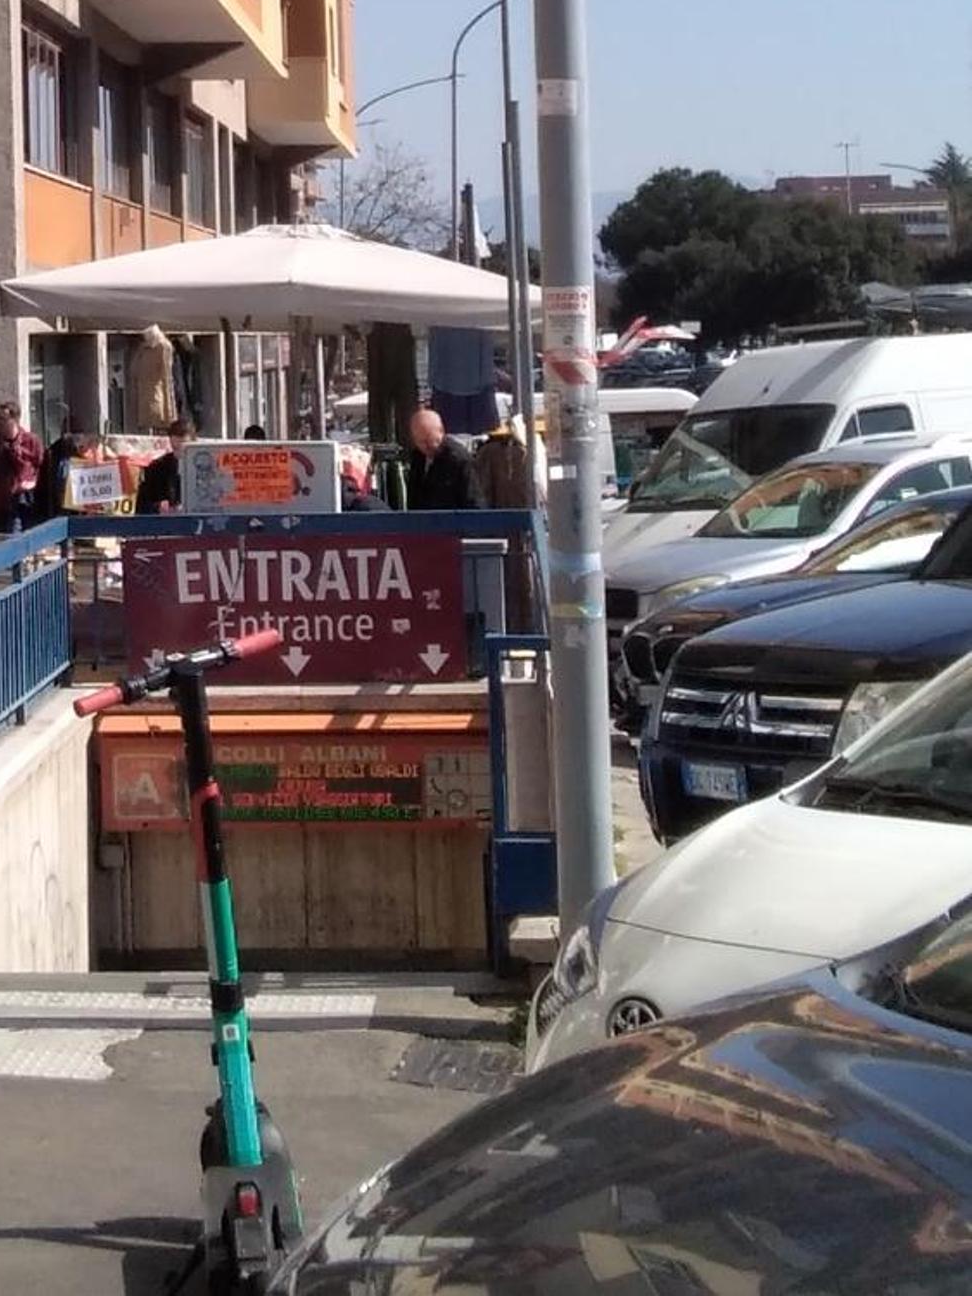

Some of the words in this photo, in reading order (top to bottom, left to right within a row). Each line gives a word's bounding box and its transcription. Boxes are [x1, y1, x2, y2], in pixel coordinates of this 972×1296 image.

[175, 548, 413, 604] ENTRATA
[217, 606, 374, 642] Entrance
[215, 745, 285, 762] COLLI
[299, 745, 388, 762] ALBANI
[131, 771, 161, 805] A
